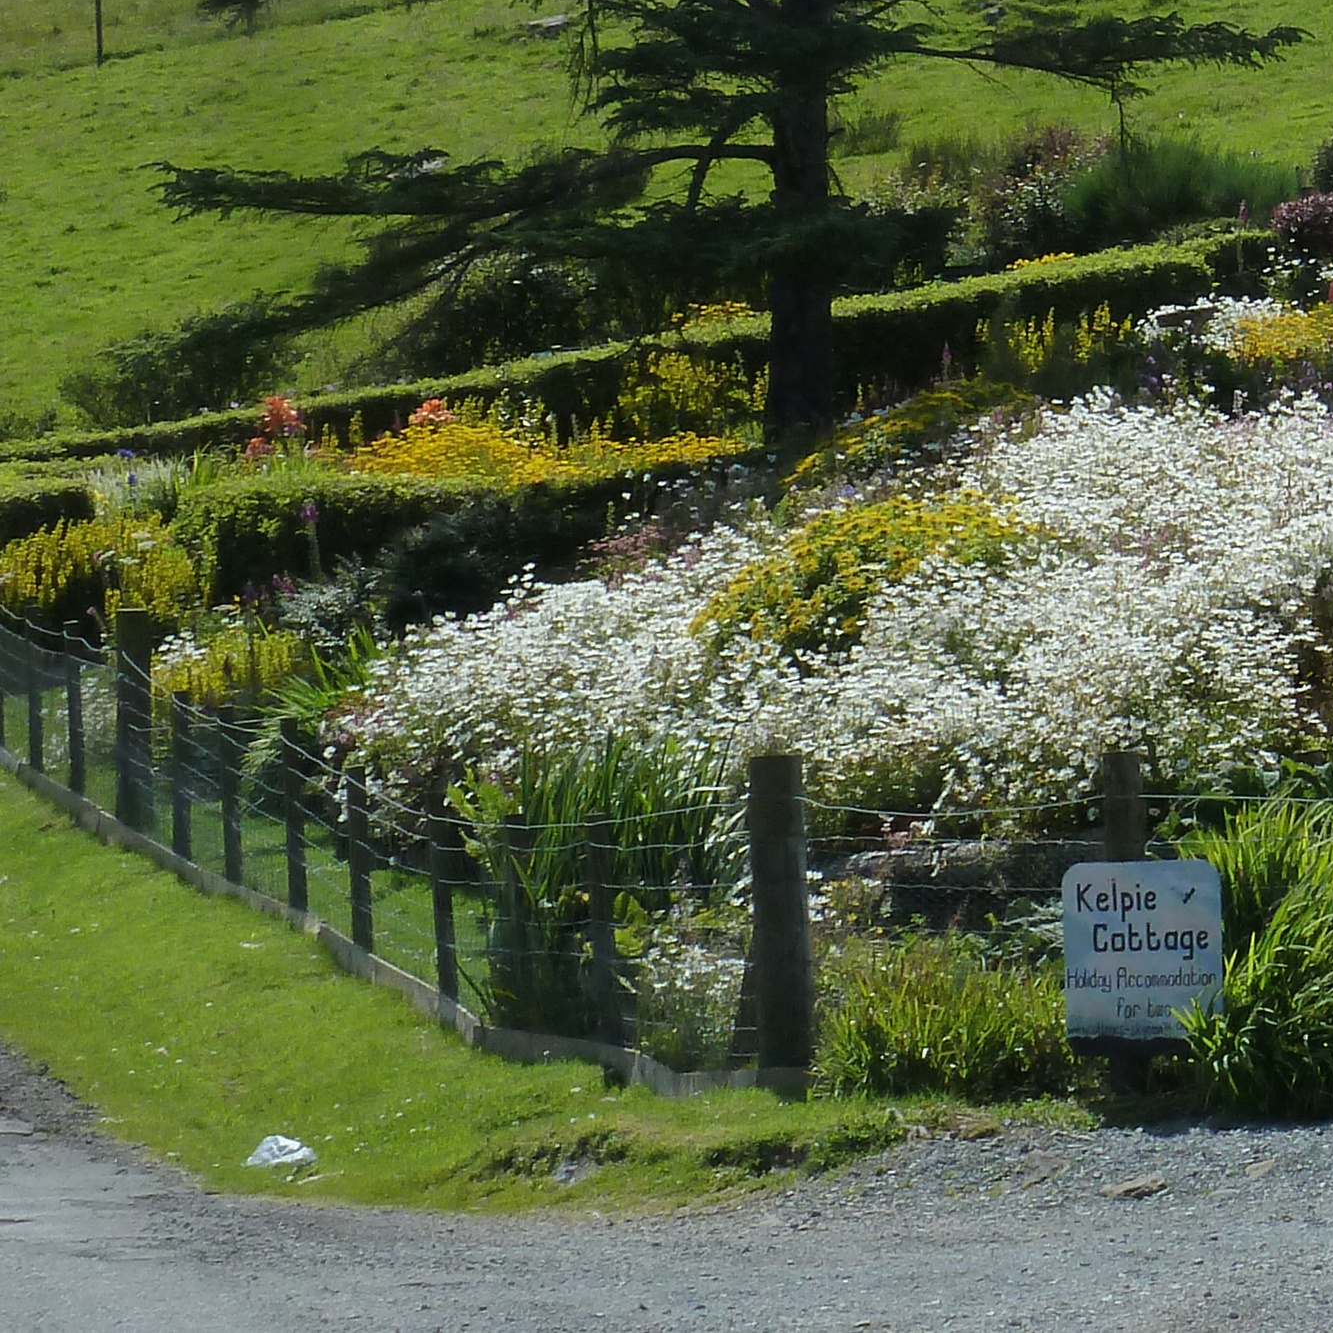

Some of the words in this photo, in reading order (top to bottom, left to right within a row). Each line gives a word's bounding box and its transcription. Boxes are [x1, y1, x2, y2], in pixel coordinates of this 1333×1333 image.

[1076, 882, 1157, 922] Kelpie
[1093, 923, 1209, 961] Cottage
[1066, 968, 1112, 993] Holiday
[1117, 997, 1140, 1018] for
